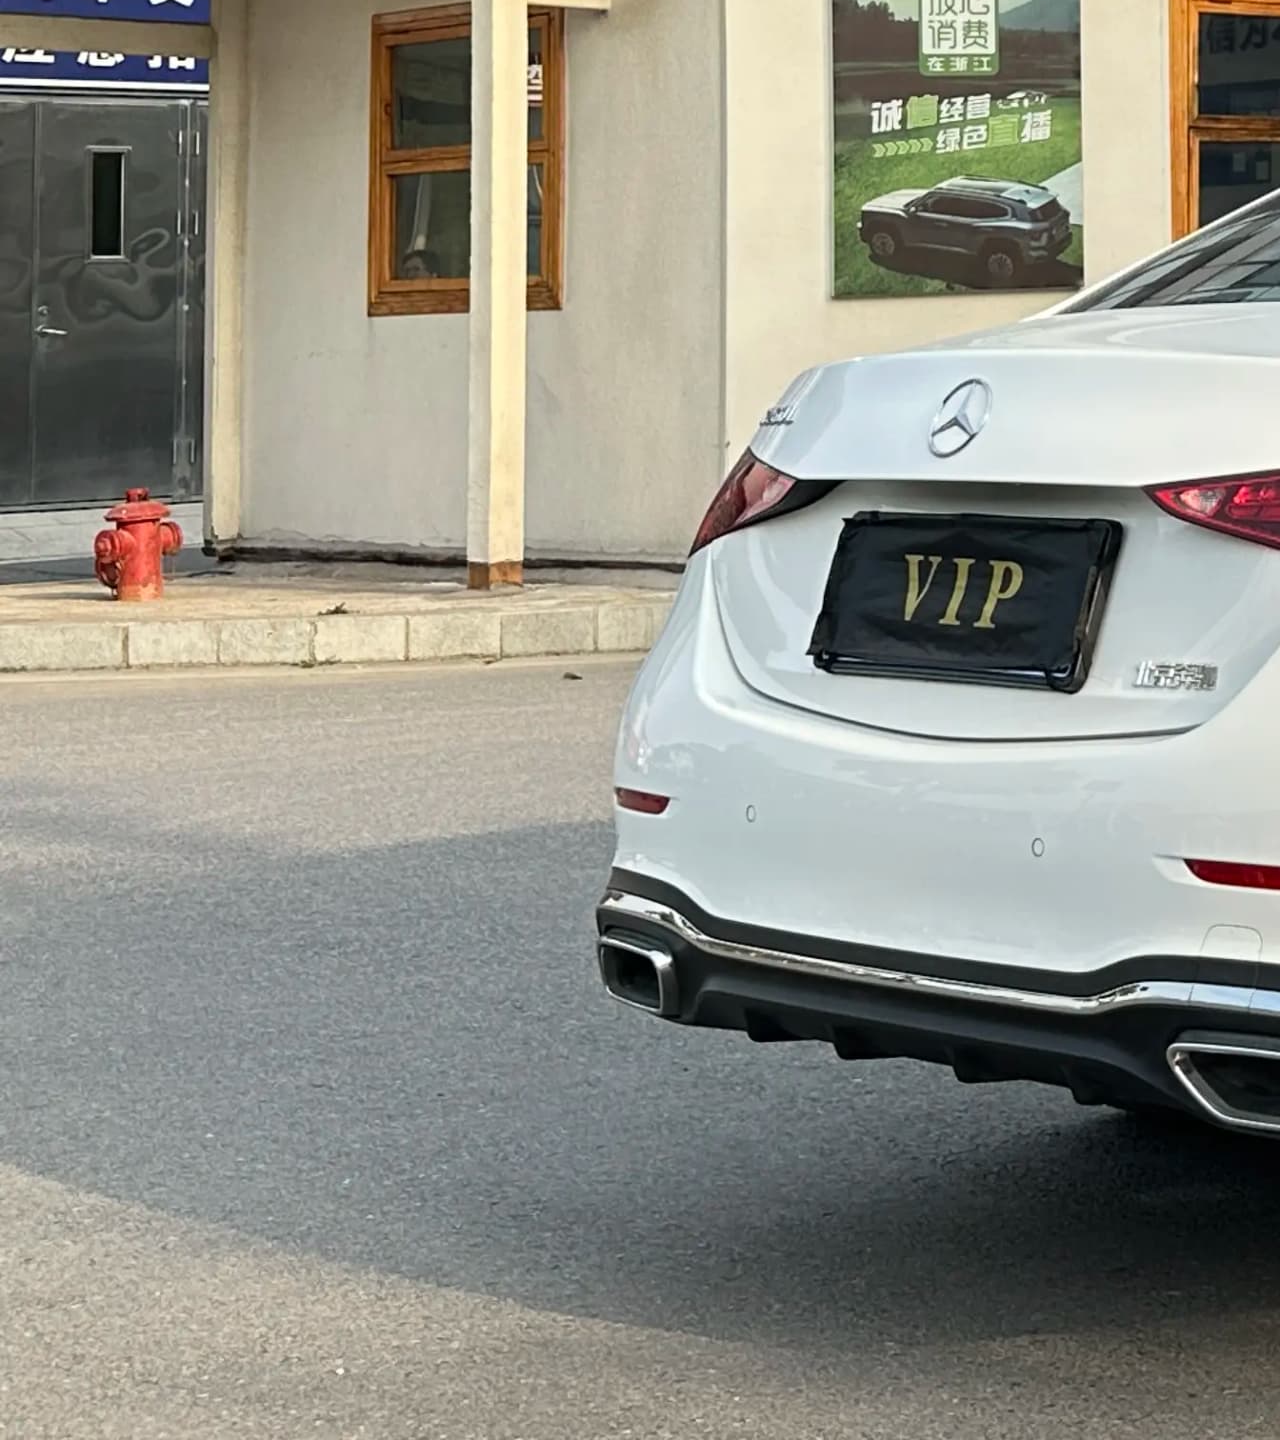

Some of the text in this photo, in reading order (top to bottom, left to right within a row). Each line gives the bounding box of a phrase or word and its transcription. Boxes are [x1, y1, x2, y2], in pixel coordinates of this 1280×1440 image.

[927, 19, 990, 50] 消费
[927, 56, 993, 72] 在浙江
[871, 93, 991, 134] 诚信经营
[935, 109, 1052, 154] 绿色直播
[904, 554, 1024, 629] VIP
